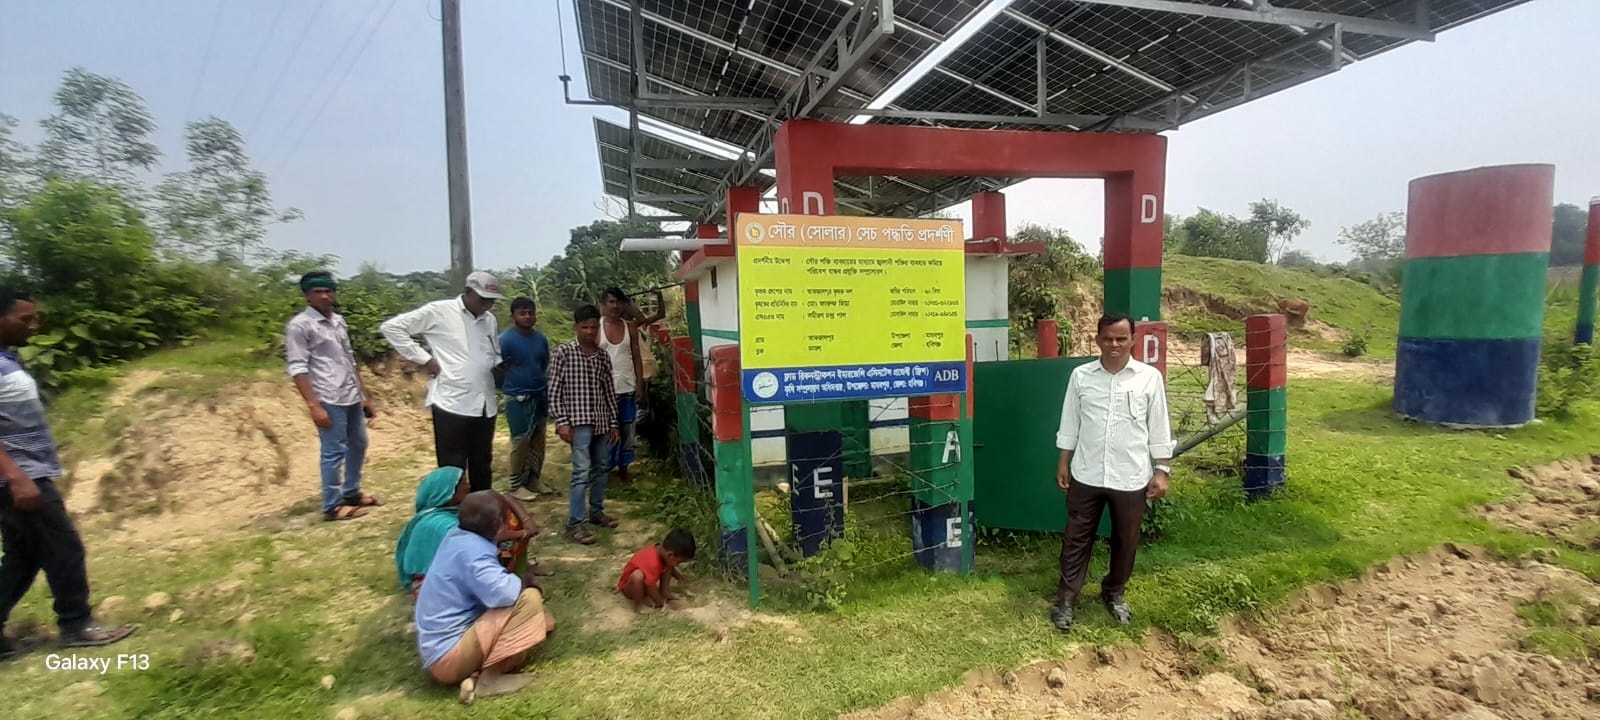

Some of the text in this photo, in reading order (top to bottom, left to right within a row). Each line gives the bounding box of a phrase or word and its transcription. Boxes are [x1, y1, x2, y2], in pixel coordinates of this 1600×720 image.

[1141, 194, 1157, 224] D
[768, 221, 796, 241] সৌর
[800, 223, 852, 242] (সোলার)
[856, 225, 878, 242] সেচ
[882, 223, 915, 242] পদ্ধতি
[1143, 334, 1160, 364] D
[934, 369, 960, 381] ADB
[941, 430, 961, 464] A
[813, 466, 834, 499] E
